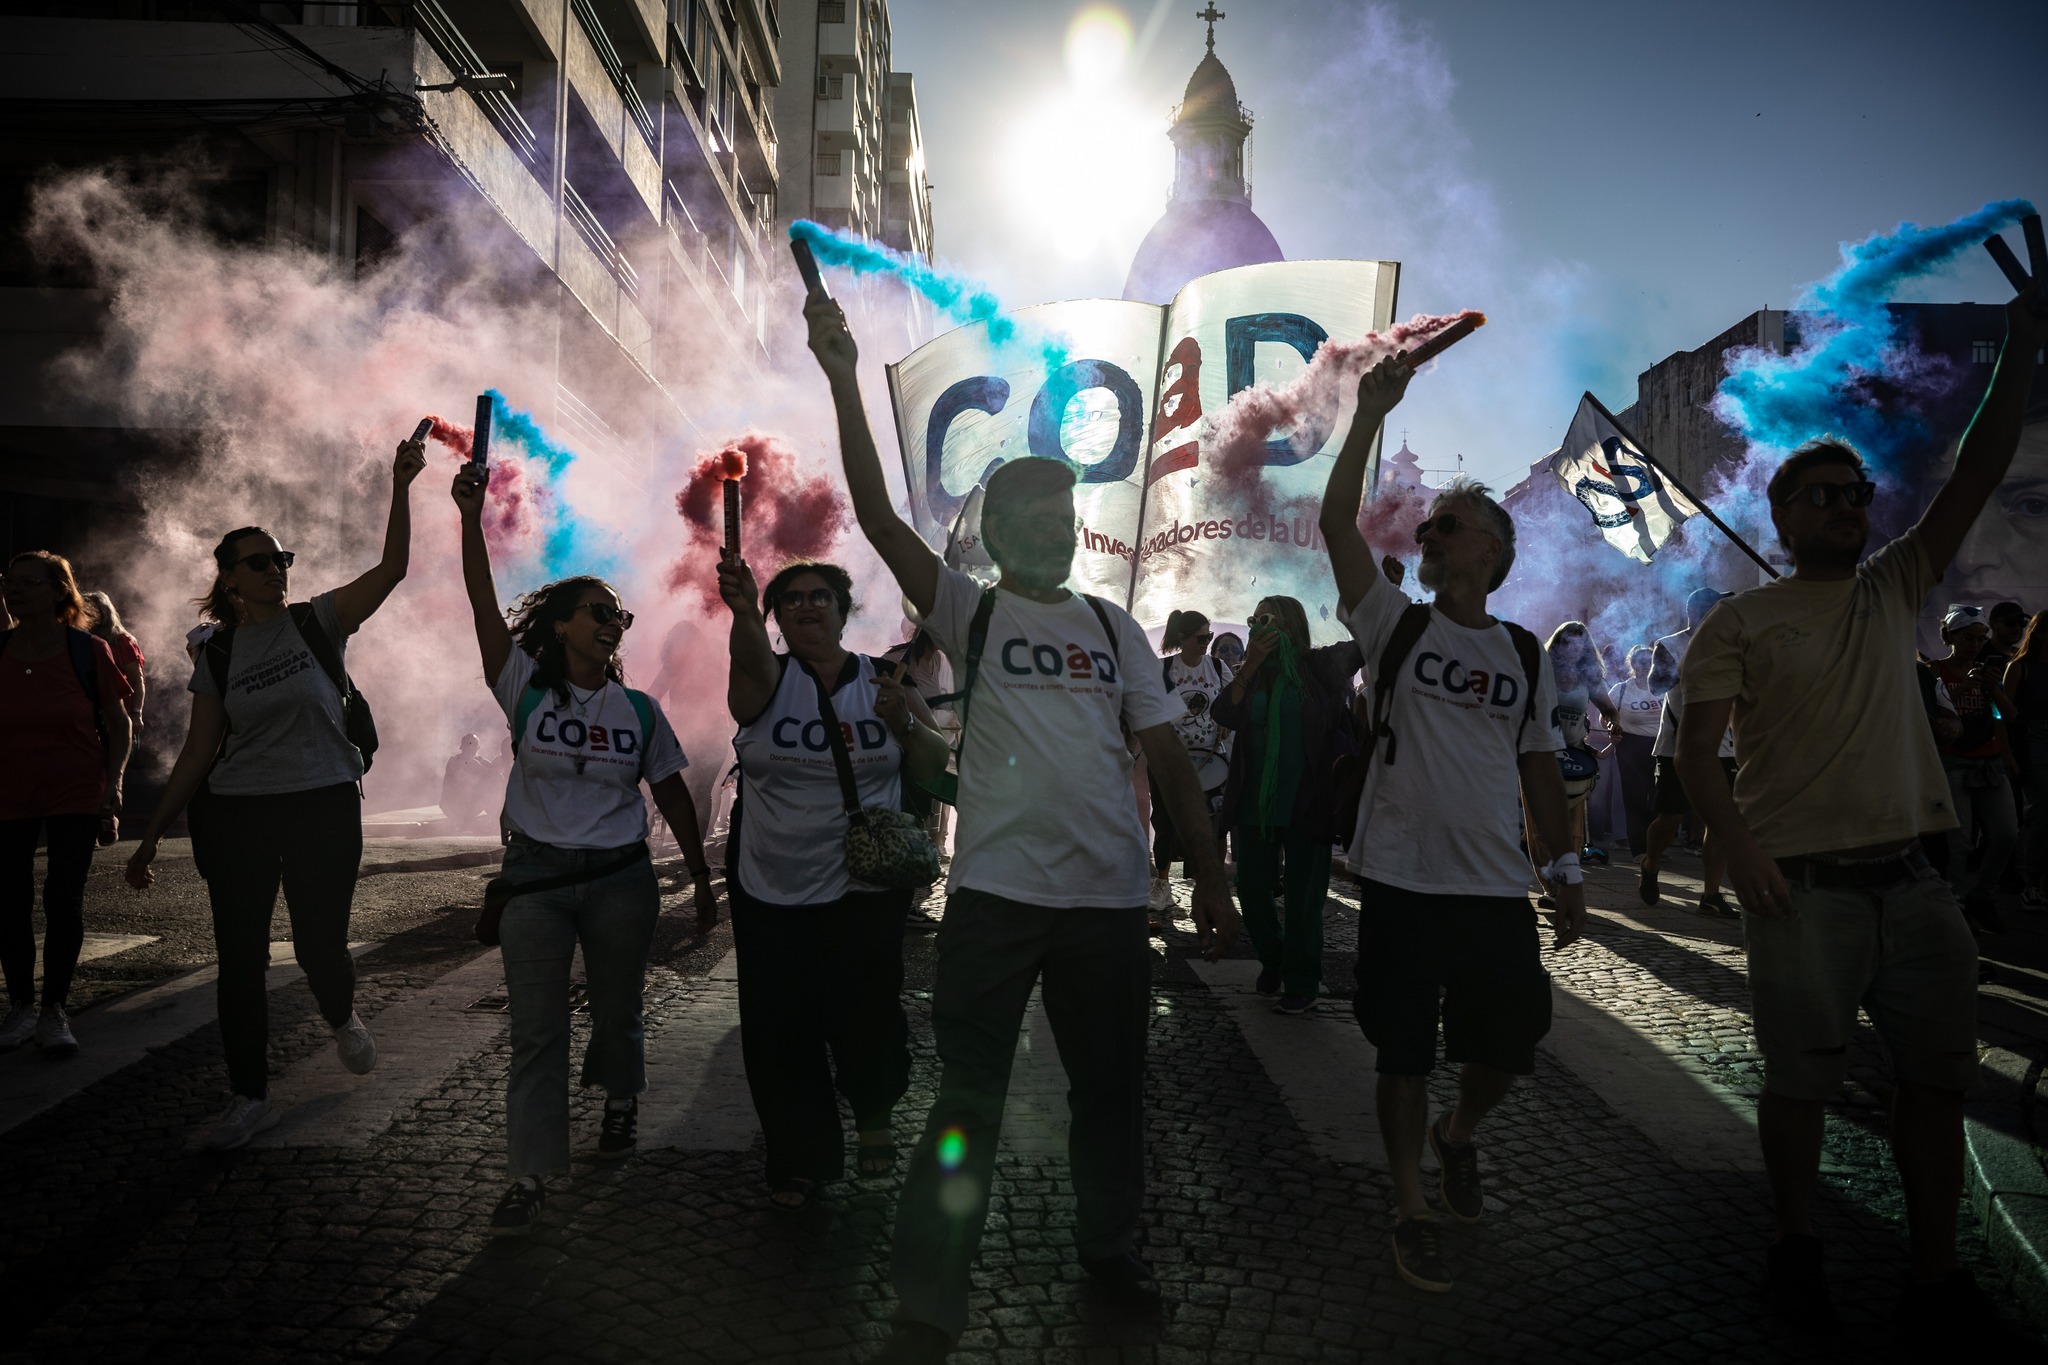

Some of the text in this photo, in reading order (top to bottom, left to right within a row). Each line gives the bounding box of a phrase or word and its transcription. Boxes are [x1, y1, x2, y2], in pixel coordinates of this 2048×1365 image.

[1235, 512, 1267, 542] de
[1269, 514, 1289, 543] la
[1293, 517, 1327, 554] UN
[231, 650, 309, 690] UNIVERSIDAD
[240, 655, 282, 676] DEFIENDO
[282, 649, 294, 659] LA
[1001, 638, 1117, 683] COaD
[1414, 651, 1518, 707] COaD
[531, 746, 557, 757] Docentes
[536, 711, 637, 754] COaD
[769, 754, 801, 763] Docentes
[867, 755, 874, 763] la
